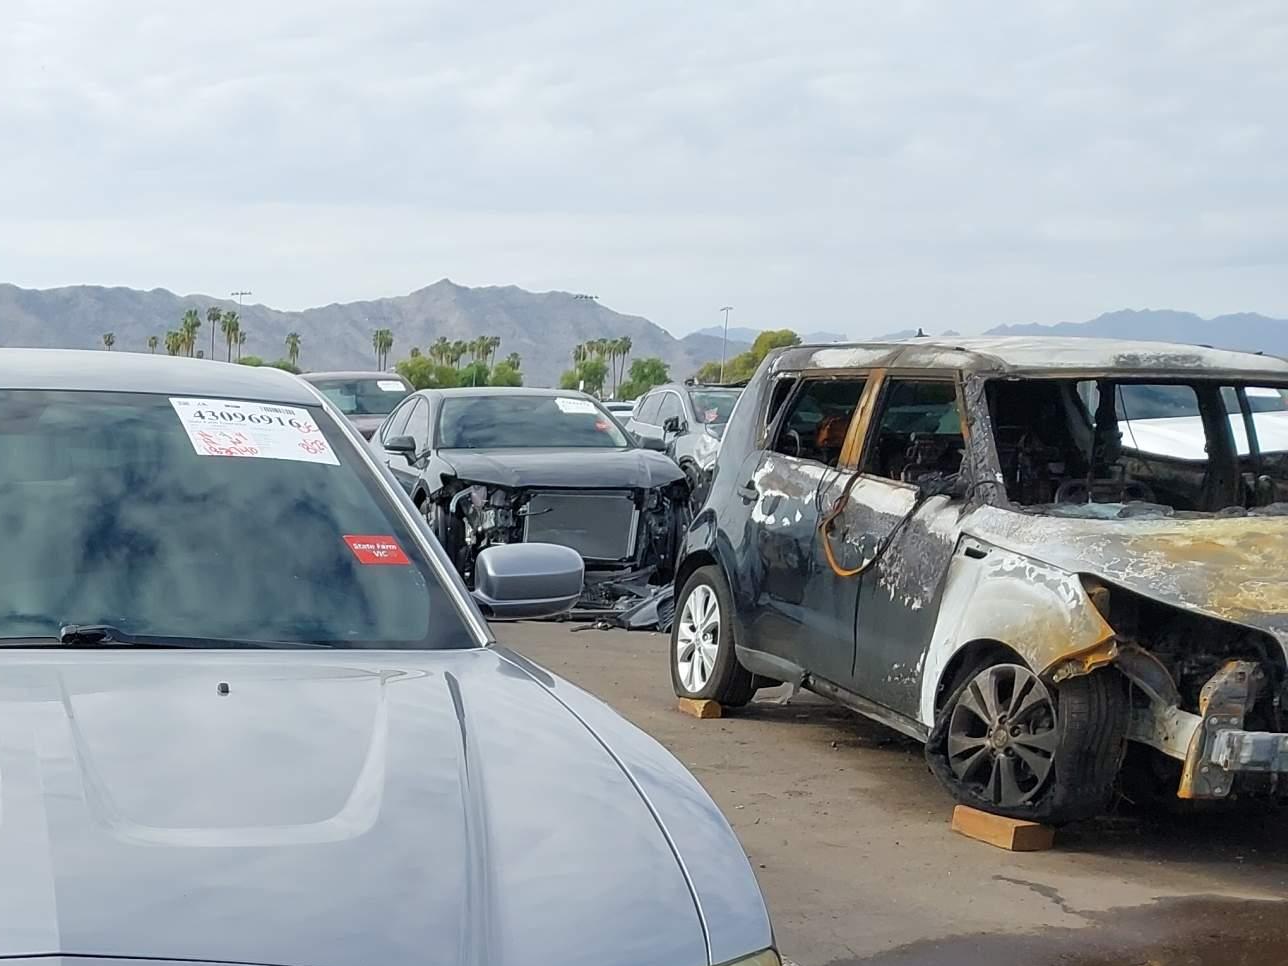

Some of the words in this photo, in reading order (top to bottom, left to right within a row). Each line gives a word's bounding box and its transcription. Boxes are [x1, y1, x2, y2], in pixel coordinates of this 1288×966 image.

[193, 410, 302, 429] 43096916
[353, 543, 375, 551] State
[376, 543, 397, 551] Farm
[372, 550, 389, 558] VIC
